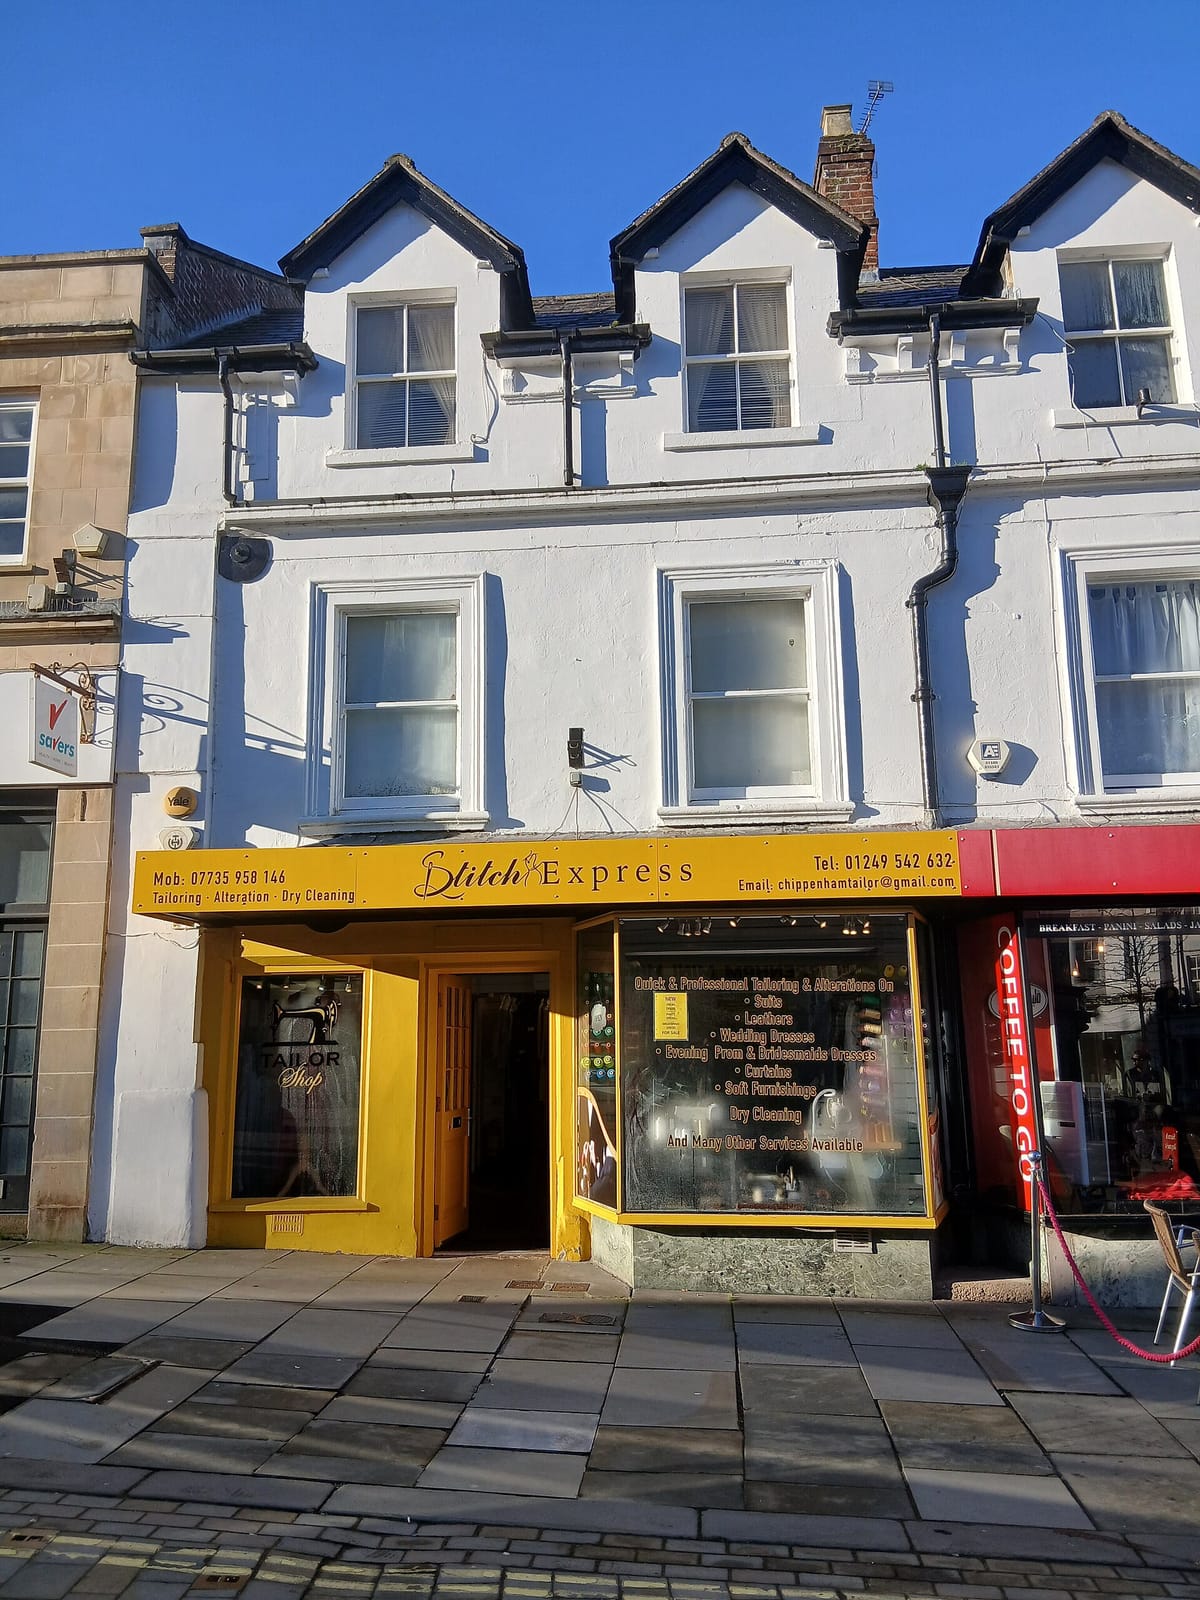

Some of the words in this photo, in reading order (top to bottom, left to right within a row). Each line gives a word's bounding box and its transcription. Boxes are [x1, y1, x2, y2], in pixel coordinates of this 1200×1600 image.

[39, 733, 75, 757] savers
[168, 797, 190, 806] Yale
[814, 856, 839, 871] Tel:
[845, 854, 888, 870] 01249
[895, 853, 921, 869] 542
[927, 853, 952, 868] 632
[153, 872, 185, 886] Mob:
[191, 871, 229, 885] 07735
[235, 871, 257, 884] 958
[264, 870, 285, 884] 146
[413, 851, 521, 900] Stitch
[542, 861, 692, 891] Express
[738, 879, 773, 891] Email:
[778, 875, 955, 892] chippenhamtailor@gmail.com
[153, 892, 201, 906] Tailoring
[214, 891, 269, 904] Alteration
[282, 889, 301, 904] Dry
[305, 889, 355, 903] Cleaning
[1039, 923, 1096, 933] BREAKFAST
[1104, 922, 1137, 931] PANINI
[1144, 920, 1182, 930] SALADS
[634, 976, 665, 991] Quick
[666, 977, 678, 991] &
[680, 976, 749, 992] Professional
[751, 977, 799, 994] Tailoring
[802, 978, 812, 992] &
[814, 978, 876, 992] Alterations
[879, 978, 894, 992] On
[998, 926, 1023, 1056] COFFEE
[754, 995, 783, 1009] Suits
[744, 1012, 793, 1026] Leathers
[720, 1028, 767, 1045] Wedding
[770, 1030, 815, 1044] Dresses
[261, 1052, 340, 1068] TAILOR
[665, 1045, 708, 1062] Evening
[714, 1047, 743, 1060] Prom
[746, 1047, 756, 1060] &
[758, 1047, 829, 1061] Bridesmaids
[832, 1048, 876, 1062] Dresses
[278, 1062, 323, 1095] Shop
[745, 1064, 792, 1078] Curtains
[724, 1081, 749, 1096] Soft
[751, 1082, 817, 1100] Furnishings
[1010, 1065, 1029, 1116] TO
[729, 1106, 750, 1124] Dry
[753, 1106, 802, 1125] Cleaning
[667, 1135, 688, 1148] And
[692, 1135, 722, 1151] Many
[725, 1136, 756, 1150] Other
[759, 1136, 808, 1151] Services
[811, 1137, 863, 1152] Available
[1016, 1125, 1035, 1182] GO
